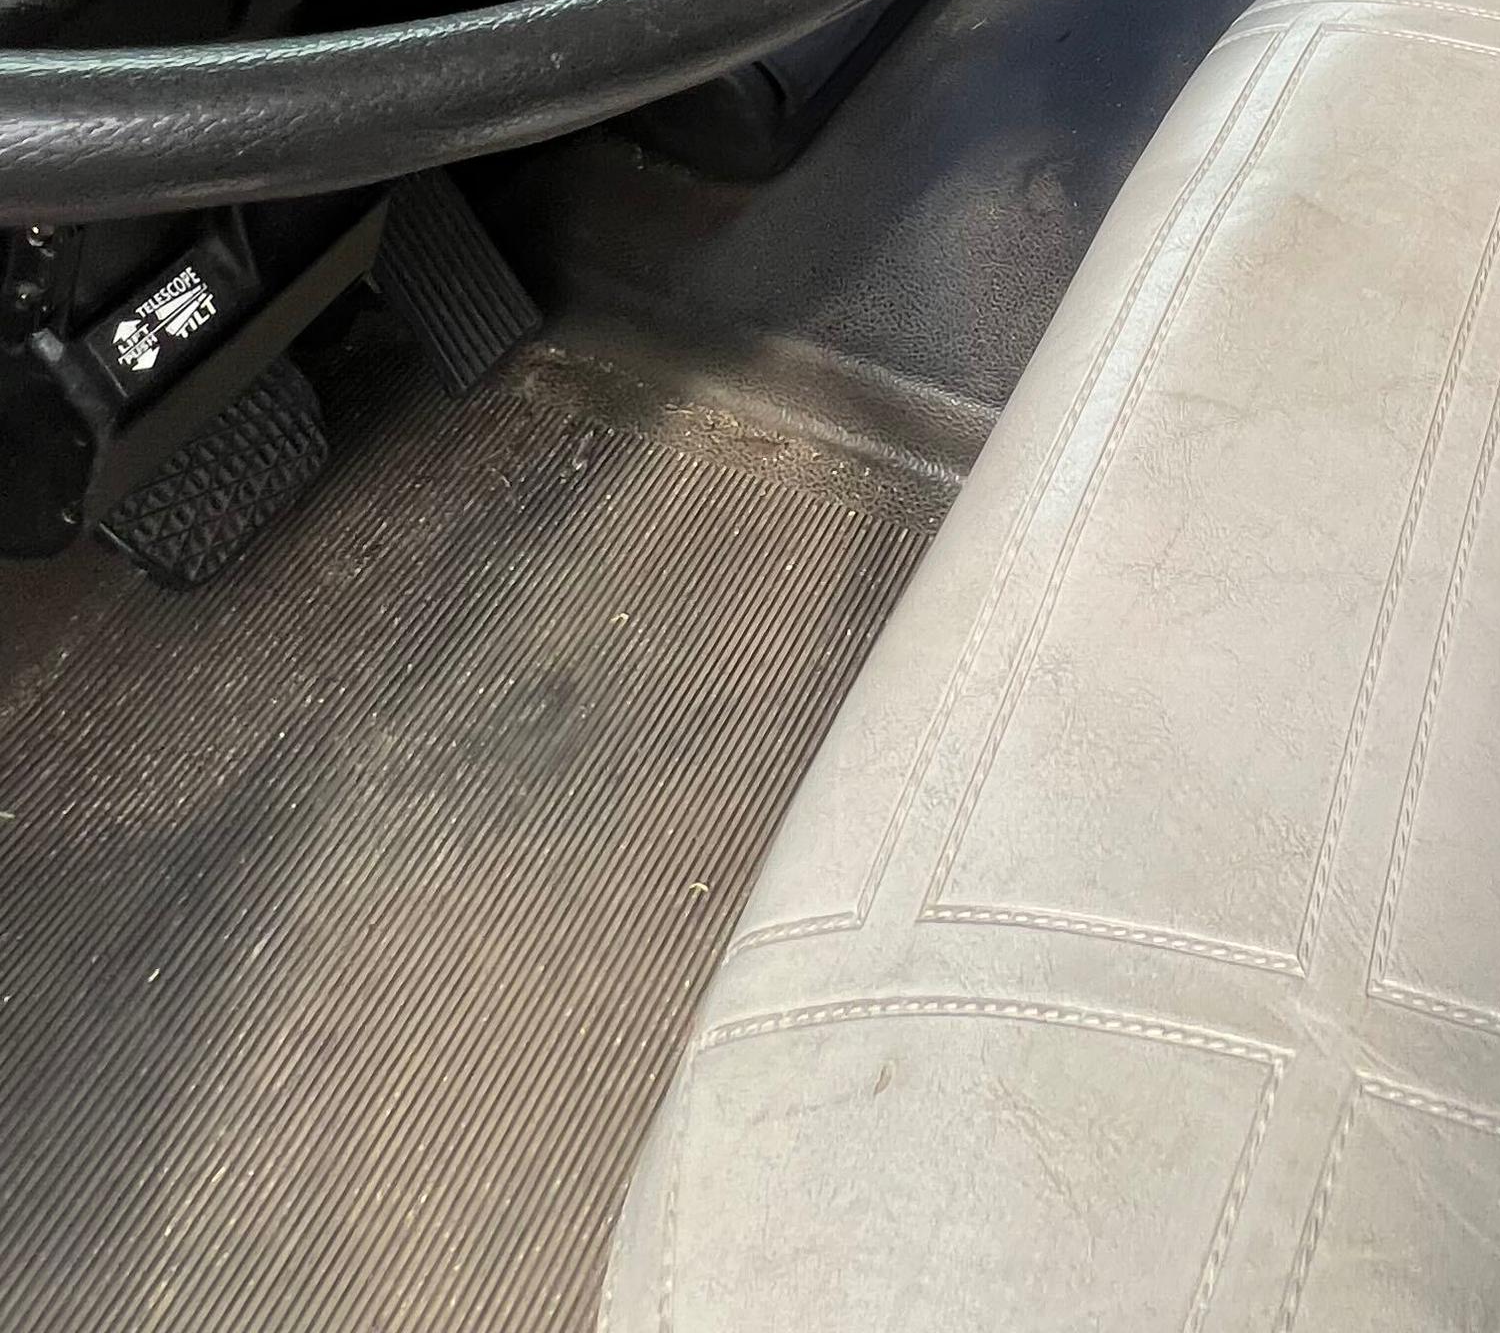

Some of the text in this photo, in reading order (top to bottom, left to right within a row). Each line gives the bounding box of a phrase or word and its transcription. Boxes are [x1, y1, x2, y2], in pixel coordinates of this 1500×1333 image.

[135, 266, 201, 318] TELESCOPE
[175, 293, 217, 339] TILT
[117, 323, 152, 354] LIFT
[118, 333, 159, 365] PUSH
